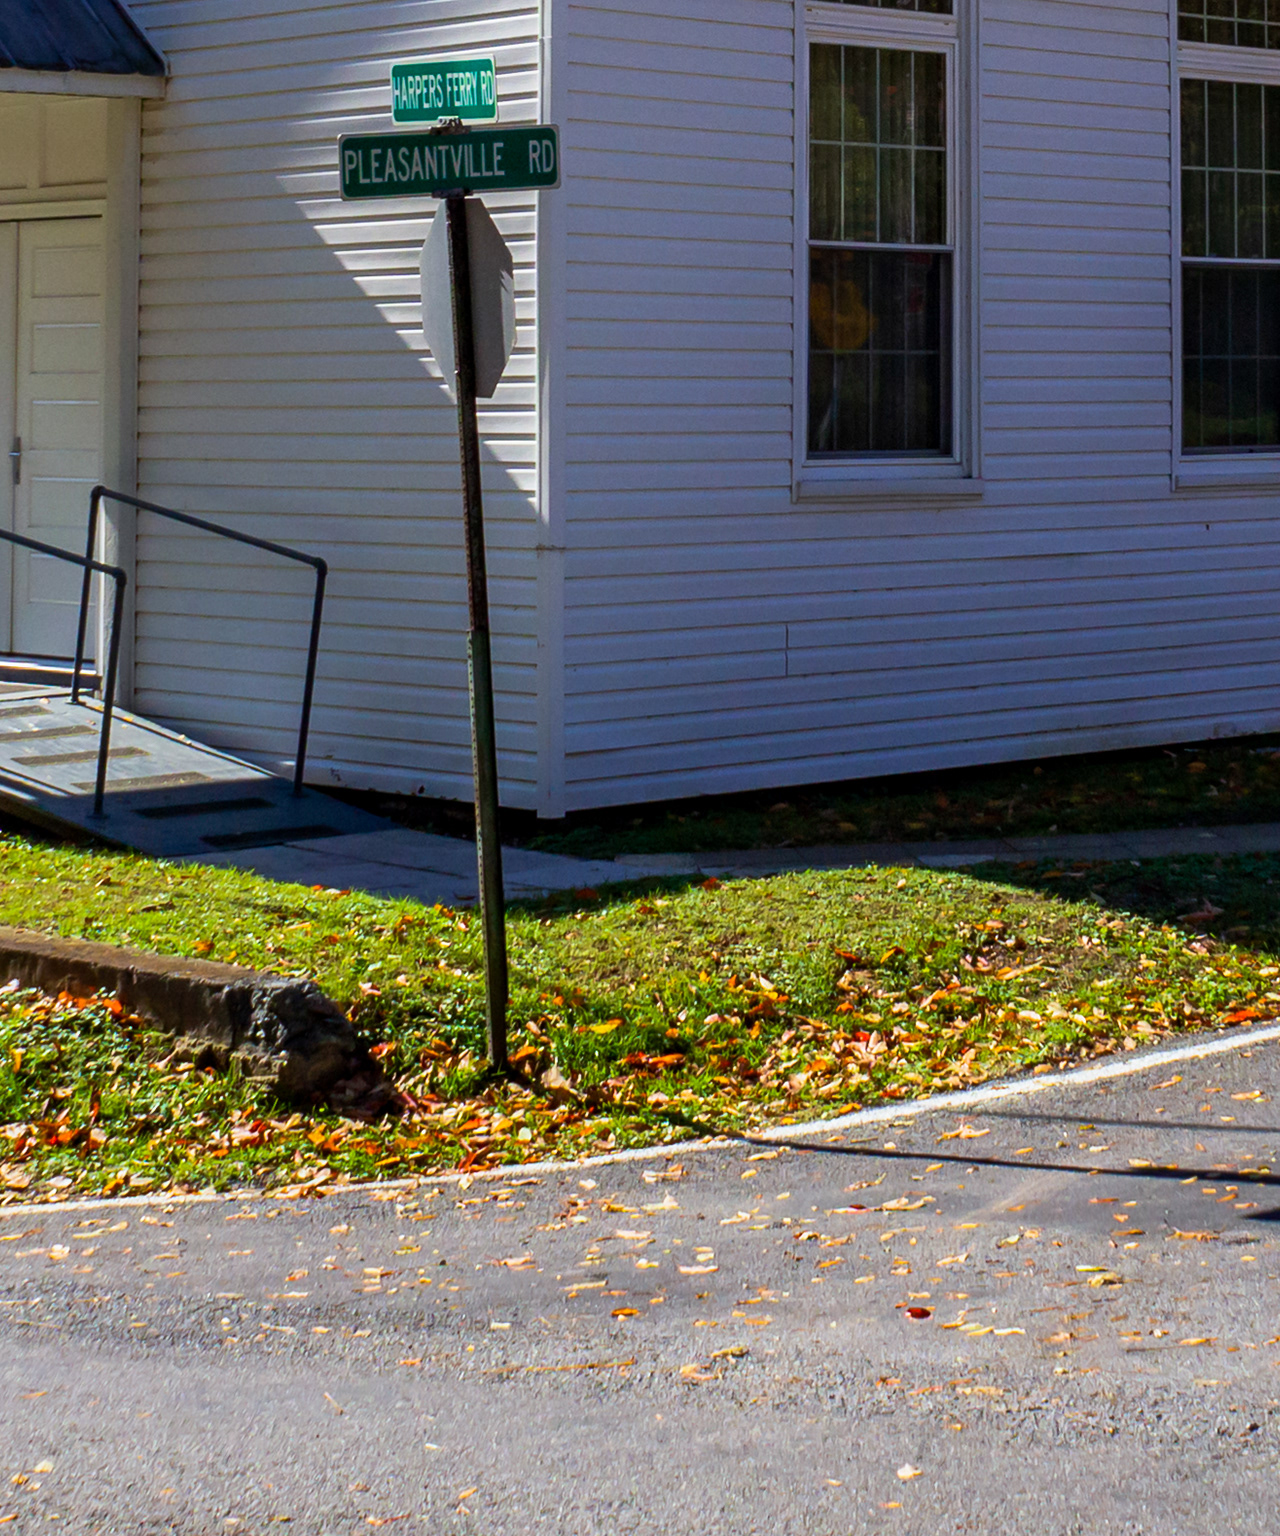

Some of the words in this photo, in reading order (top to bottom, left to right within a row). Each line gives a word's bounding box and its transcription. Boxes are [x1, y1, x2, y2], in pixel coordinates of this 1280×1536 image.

[392, 73, 443, 110] HARPERS
[446, 71, 478, 108] FERRY
[480, 70, 494, 106] RD
[344, 141, 505, 185] PLEASANTVILLE
[528, 139, 555, 174] RD
